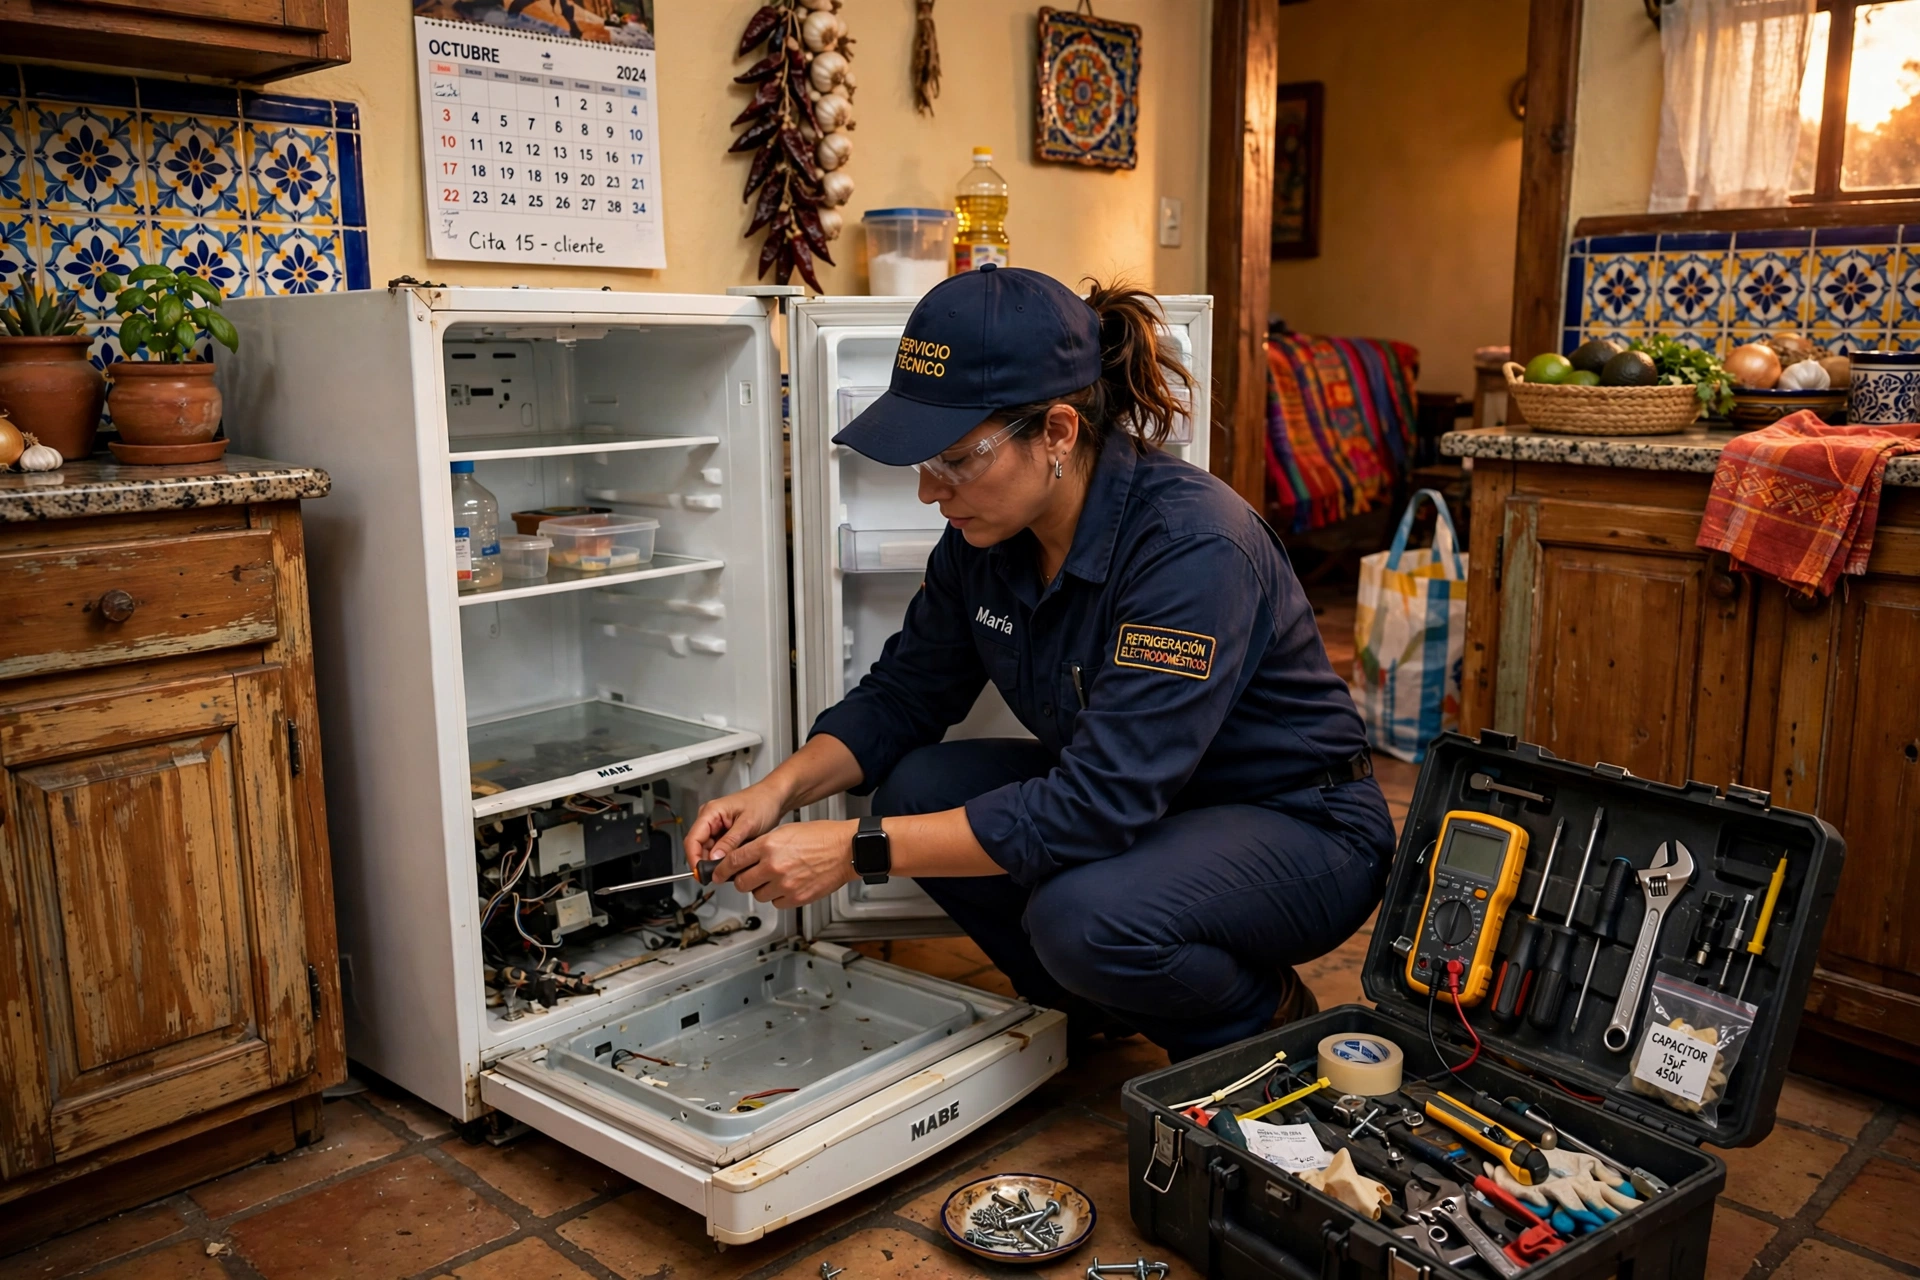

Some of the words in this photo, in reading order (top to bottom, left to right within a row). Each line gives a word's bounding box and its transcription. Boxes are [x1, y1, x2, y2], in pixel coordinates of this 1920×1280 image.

[429, 40, 500, 63] OCTUBRE
[617, 66, 646, 83] 2024
[555, 96, 560, 108] 1
[580, 98, 588, 111] 2
[605, 101, 613, 113] 3
[631, 105, 638, 116] 4
[443, 108, 451, 122] 3
[471, 111, 479, 124] 4
[500, 115, 508, 127] 5
[528, 117, 536, 130] 7
[555, 120, 563, 133] 6
[581, 123, 589, 136] 8
[606, 126, 614, 138] 9
[629, 129, 643, 141] 10
[441, 135, 456, 148] 10
[470, 138, 483, 151] 11
[499, 140, 513, 154] 12
[526, 143, 541, 156] 12
[553, 146, 567, 159] 13
[579, 148, 593, 161] 15
[606, 151, 619, 163] 16
[631, 153, 643, 165] 17
[443, 162, 458, 175] 17
[471, 164, 487, 177] 18
[500, 167, 514, 180] 19
[528, 169, 542, 182] 18
[555, 171, 569, 184] 19
[580, 173, 595, 187] 20
[631, 178, 645, 190] 21
[443, 188, 460, 202] 22
[472, 190, 488, 204] 23
[500, 192, 516, 206] 24
[528, 194, 544, 208] 25
[555, 196, 571, 210] 26
[632, 201, 646, 214] 34
[469, 231, 506, 250] Cita
[515, 233, 534, 251] 15
[554, 235, 606, 254] cliente
[900, 336, 951, 360] SERVICIO
[896, 352, 945, 377] TÉCNICO
[975, 606, 1013, 635] María
[1125, 632, 1206, 657] REFRIGERACIÓN
[597, 764, 633, 778] MABE
[1651, 1032, 1708, 1064] CAPACITOR
[1655, 1066, 1683, 1085] 450V
[911, 1100, 960, 1142] MABE
